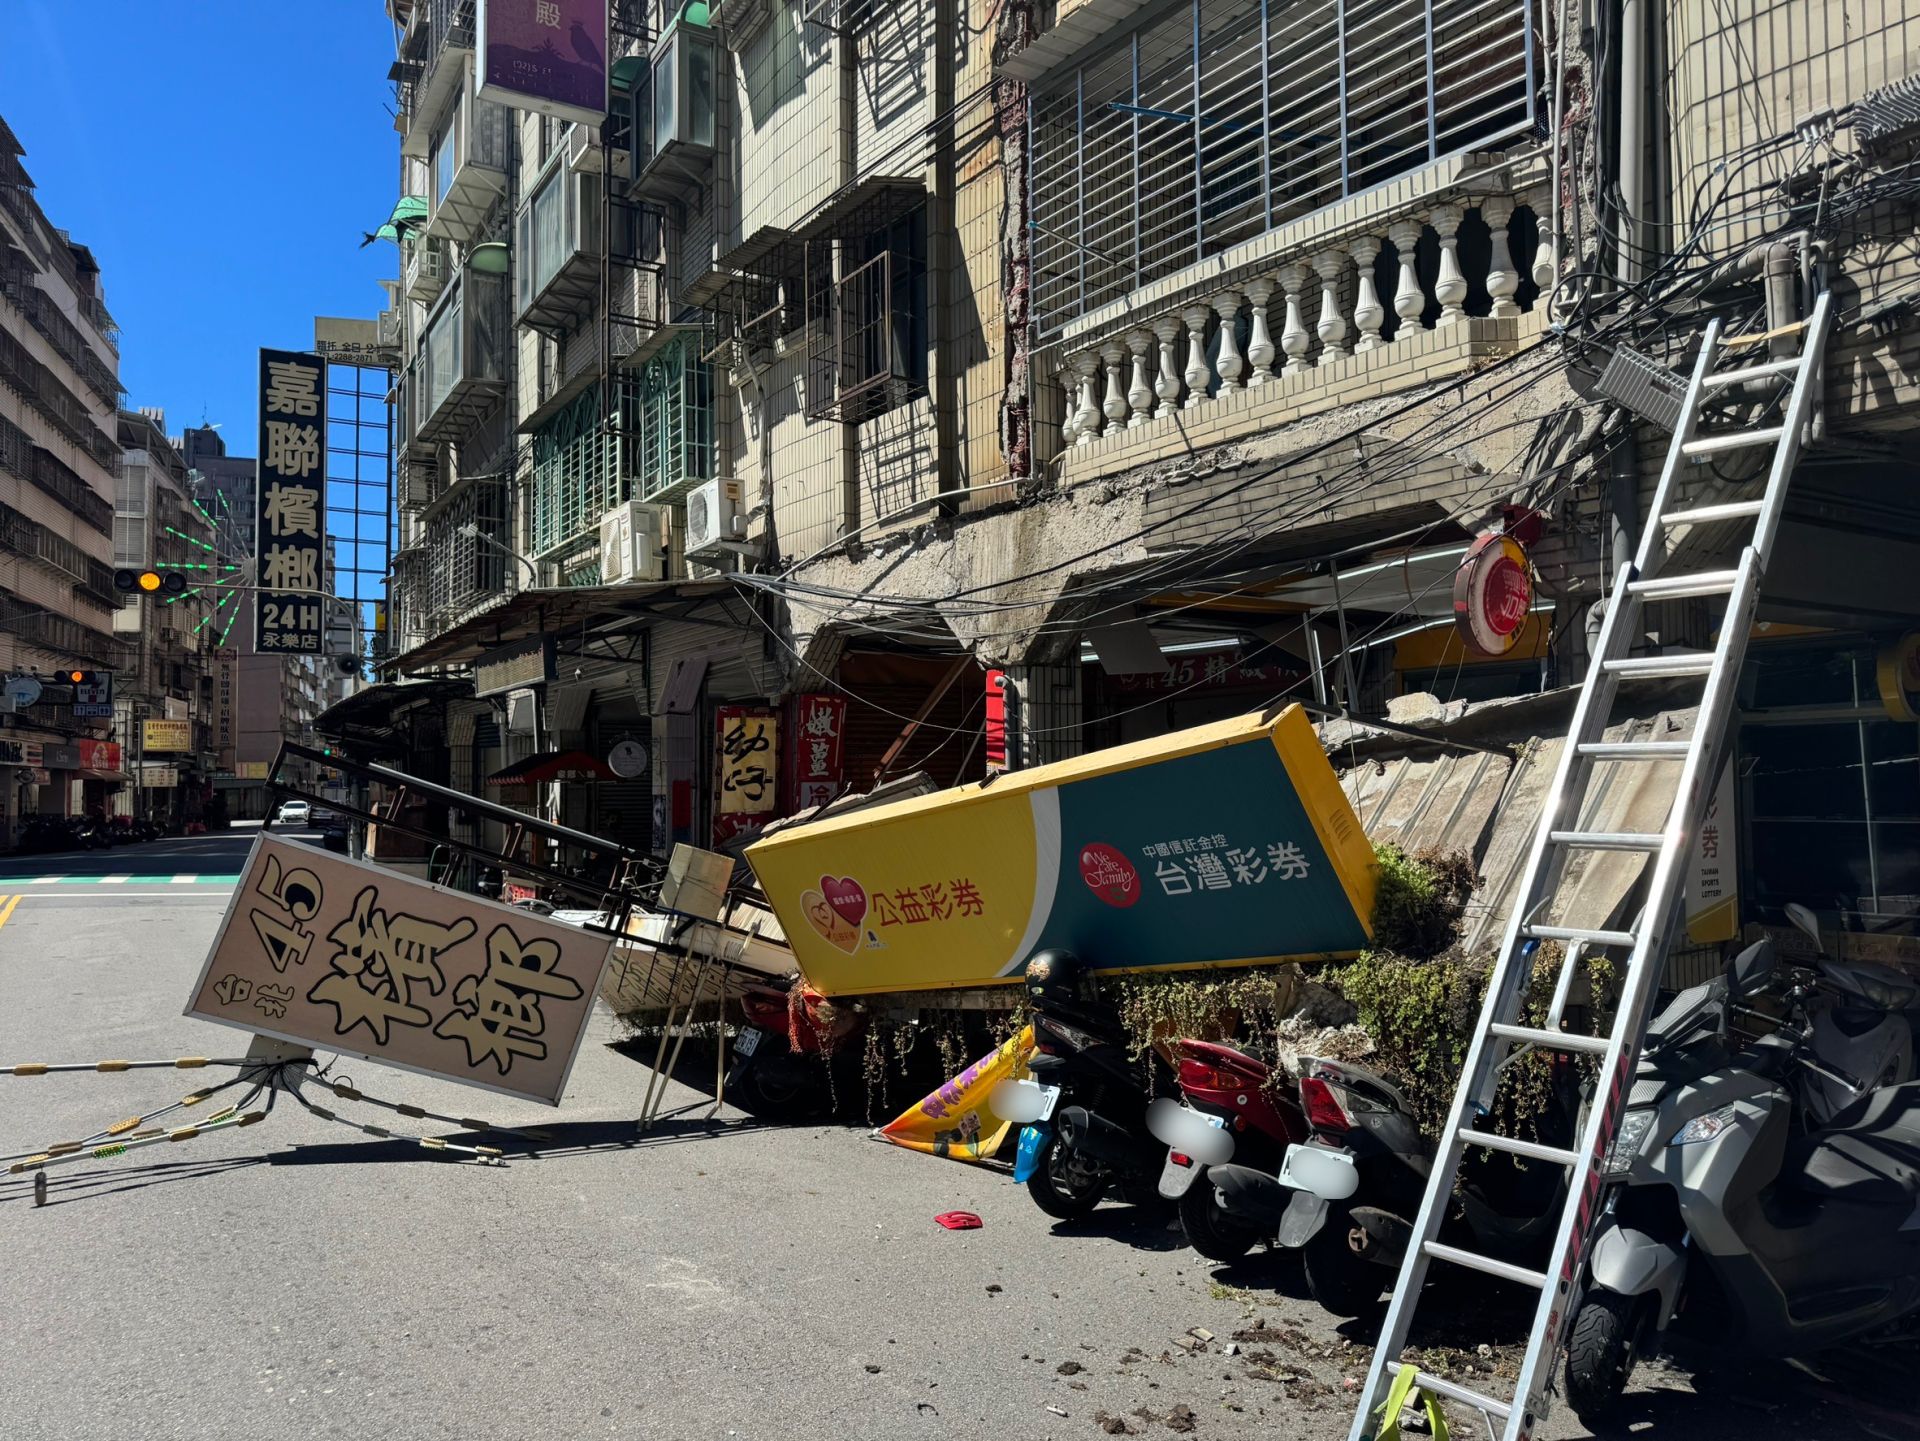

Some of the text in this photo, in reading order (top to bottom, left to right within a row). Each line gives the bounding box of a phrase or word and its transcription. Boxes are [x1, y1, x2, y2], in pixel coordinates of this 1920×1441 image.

[342, 343, 361, 353] 全日
[264, 361, 320, 600] 嘉聯檳榔
[263, 603, 318, 631] 24H
[263, 632, 318, 650] 永樂店
[1087, 851, 1110, 865] We
[1142, 833, 1229, 859] 中國信託金控
[1104, 861, 1119, 873] are
[1154, 841, 1312, 896] 台灣彩券
[1702, 879, 1720, 887] SPORTS
[1702, 890, 1722, 898] LOTTERY
[250, 853, 324, 973] 45
[872, 878, 985, 927] 公益彩券
[306, 885, 585, 1077] 檳榔
[212, 973, 295, 1019] 台北
